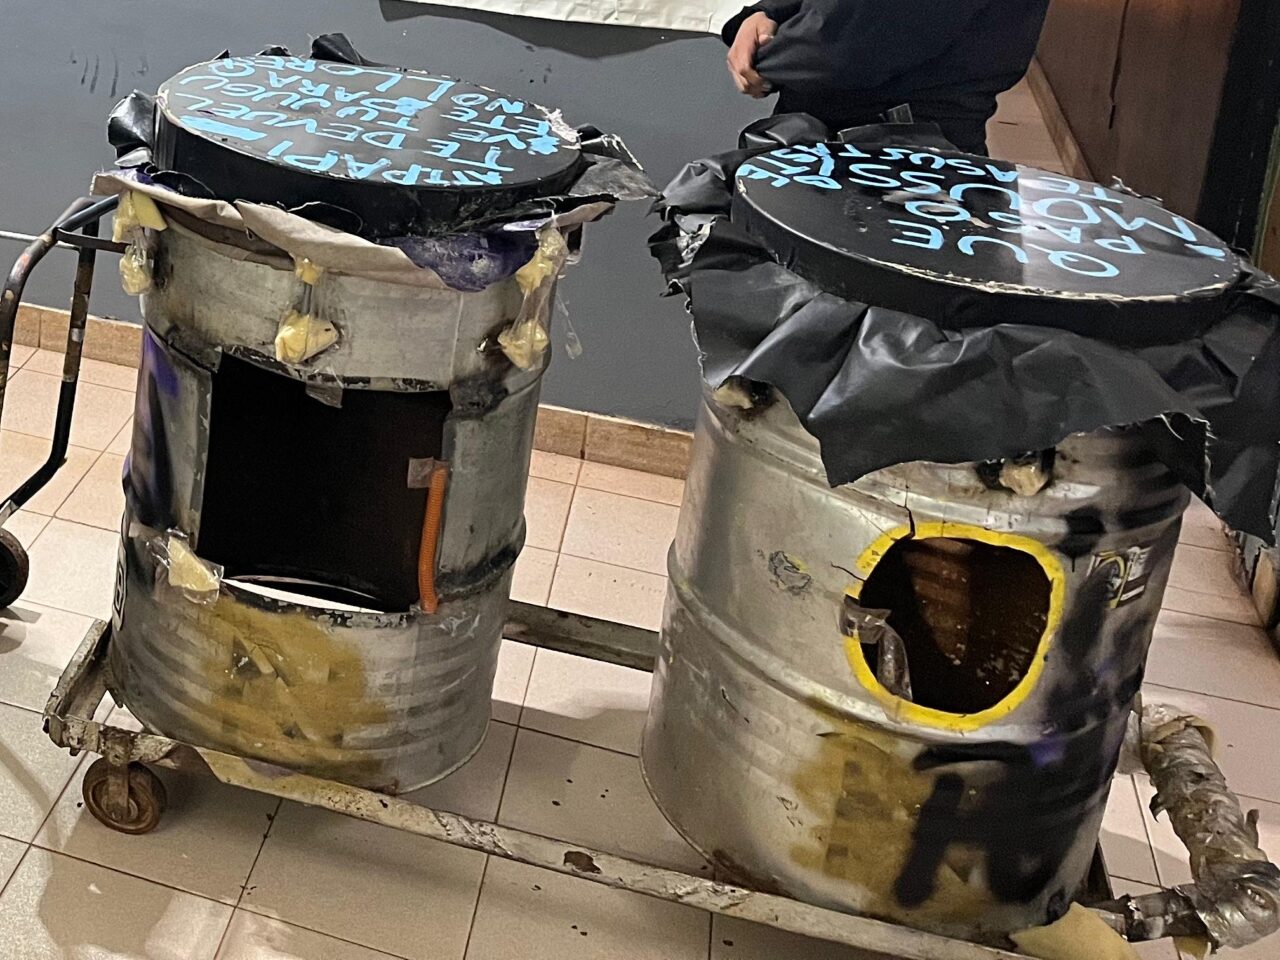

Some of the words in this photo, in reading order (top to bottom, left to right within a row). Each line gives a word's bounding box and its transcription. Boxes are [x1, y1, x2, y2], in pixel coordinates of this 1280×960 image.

[178, 75, 332, 110] JUGU
[449, 93, 526, 114] NO
[175, 93, 407, 149] DEVUEL
[335, 106, 419, 131] TU
[422, 138, 515, 171] TE
[1039, 176, 1125, 204] TE
[905, 200, 1147, 255] PASO
[892, 218, 1120, 278] QUE
